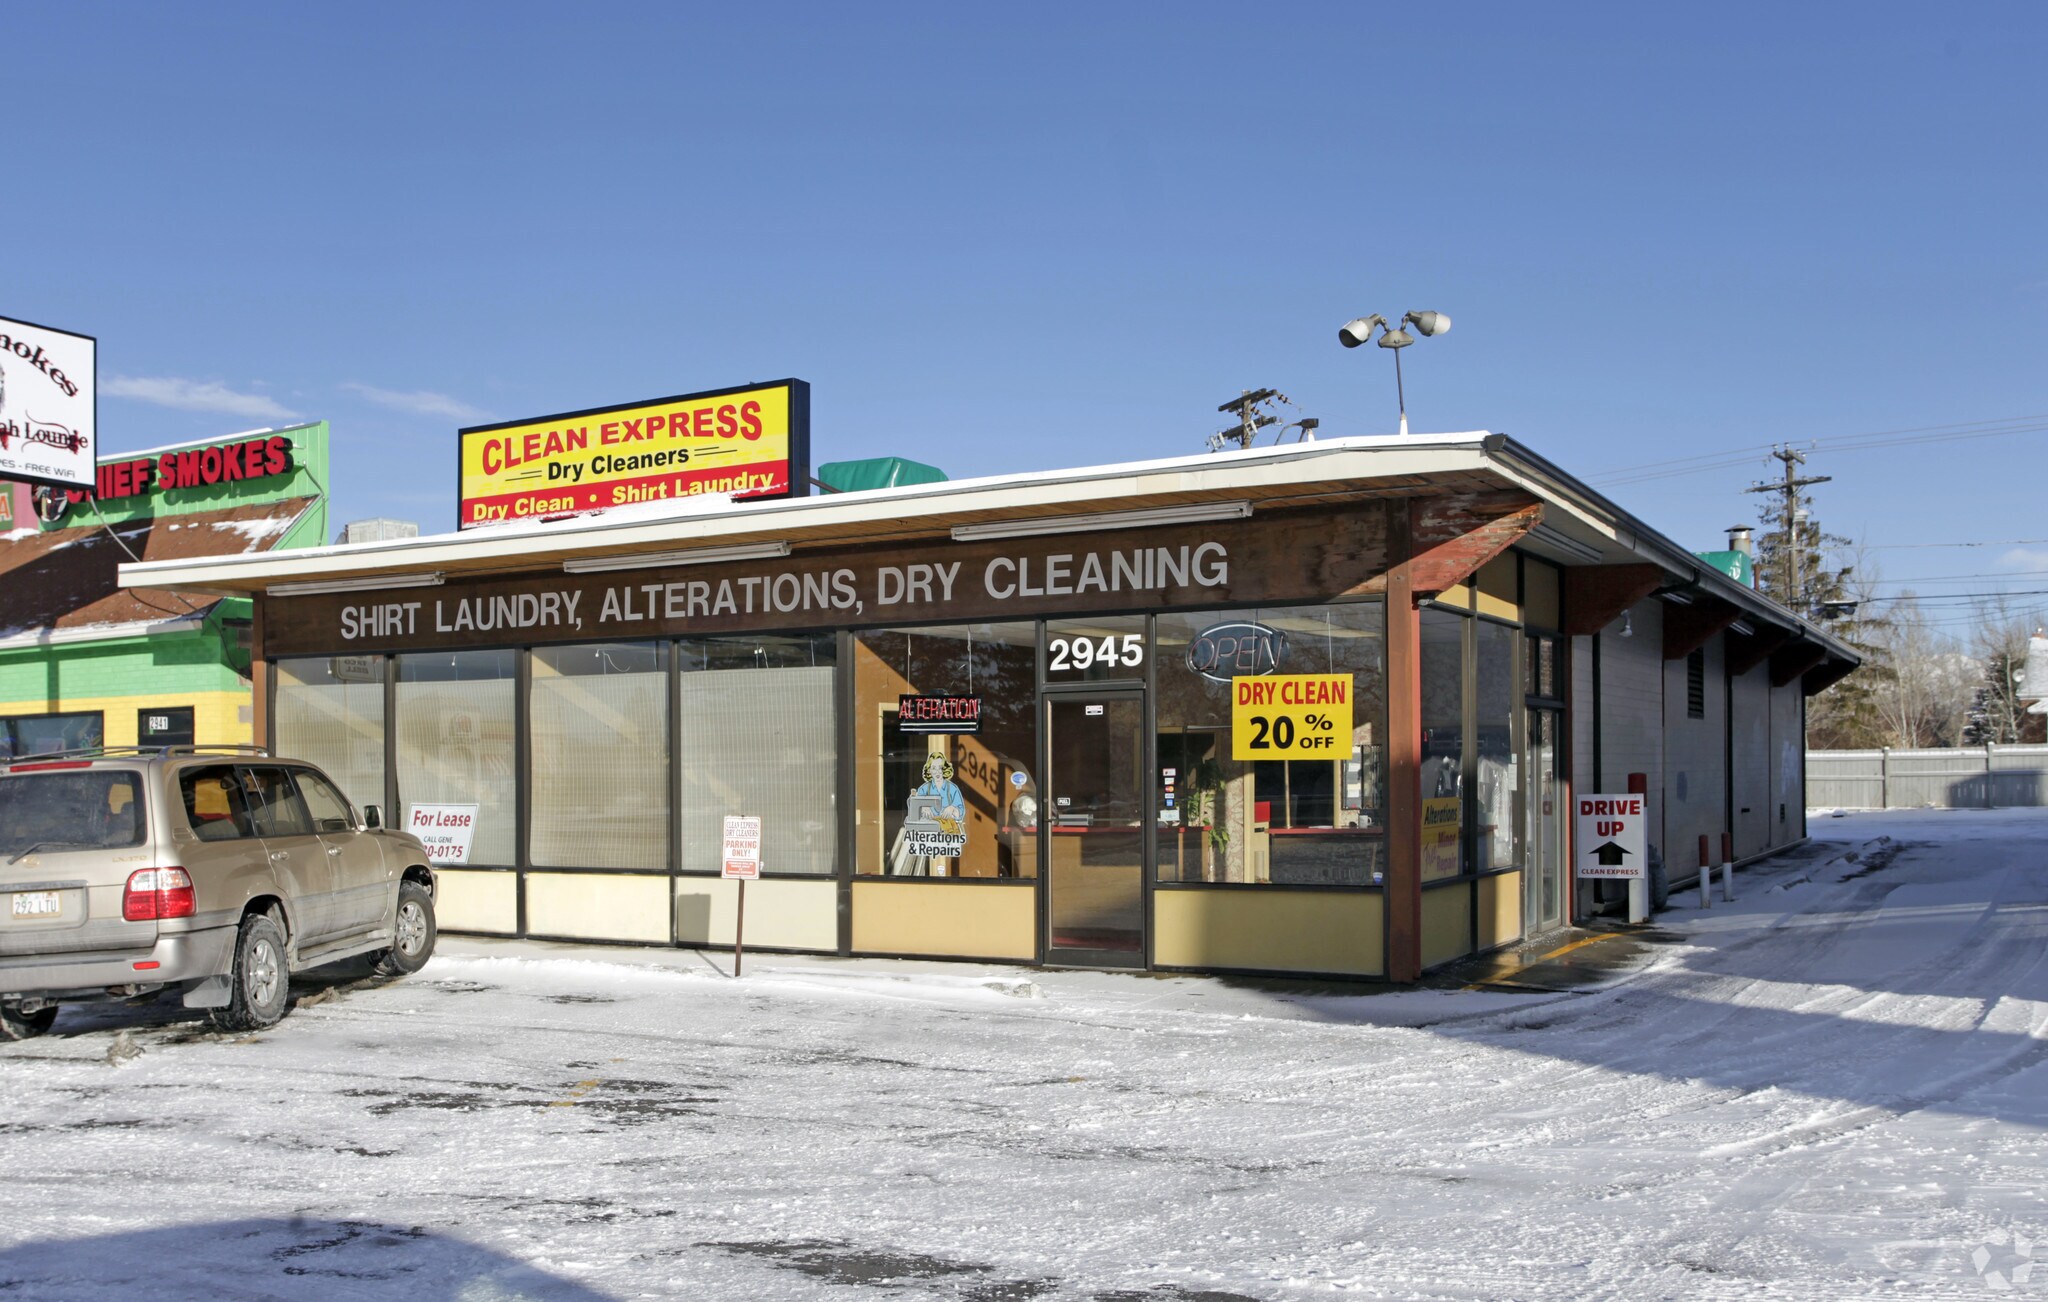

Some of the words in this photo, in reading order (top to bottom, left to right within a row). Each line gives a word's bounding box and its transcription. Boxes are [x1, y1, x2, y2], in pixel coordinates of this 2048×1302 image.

[482, 426, 587, 475] CLEAN
[600, 400, 763, 445] EXPRESS
[25, 462, 51, 474] FREE
[158, 435, 288, 490] SMOKES
[548, 462, 584, 482] Dry
[591, 449, 690, 474] Cleaners
[473, 502, 507, 521] Dry
[523, 495, 575, 514] Clean
[612, 481, 667, 504] Shirt
[675, 471, 774, 497] Laundry
[340, 601, 421, 640] SHIRT
[435, 590, 582, 631] LAUNDRY,
[599, 569, 864, 623] ALTERATIONS,
[878, 561, 962, 606] DRY
[984, 542, 1229, 600] CLEANING
[1049, 634, 1143, 671] 2945
[1189, 635, 1285, 672] OPEN
[1238, 682, 1277, 706] DRY
[1281, 681, 1346, 705] CLEAN
[899, 698, 978, 719] ALTERATION
[150, 717, 167, 729] 2941
[1249, 716, 1295, 750] 20
[1304, 714, 1334, 732] %
[1300, 737, 1335, 749] OFF
[1424, 803, 1458, 826] Alterations
[1580, 800, 1641, 816] DRIVE
[413, 810, 434, 827] For
[436, 810, 471, 827] Lease
[904, 830, 966, 844] Alterations
[1597, 821, 1625, 837] UP
[424, 835, 437, 843] CALL
[438, 836, 453, 844] GENE
[726, 840, 757, 849] PARKING
[908, 843, 918, 856] &
[919, 843, 961, 859] Repairs
[1581, 868, 1606, 876] CLEAN
[1606, 868, 1639, 876] EXPRESS
